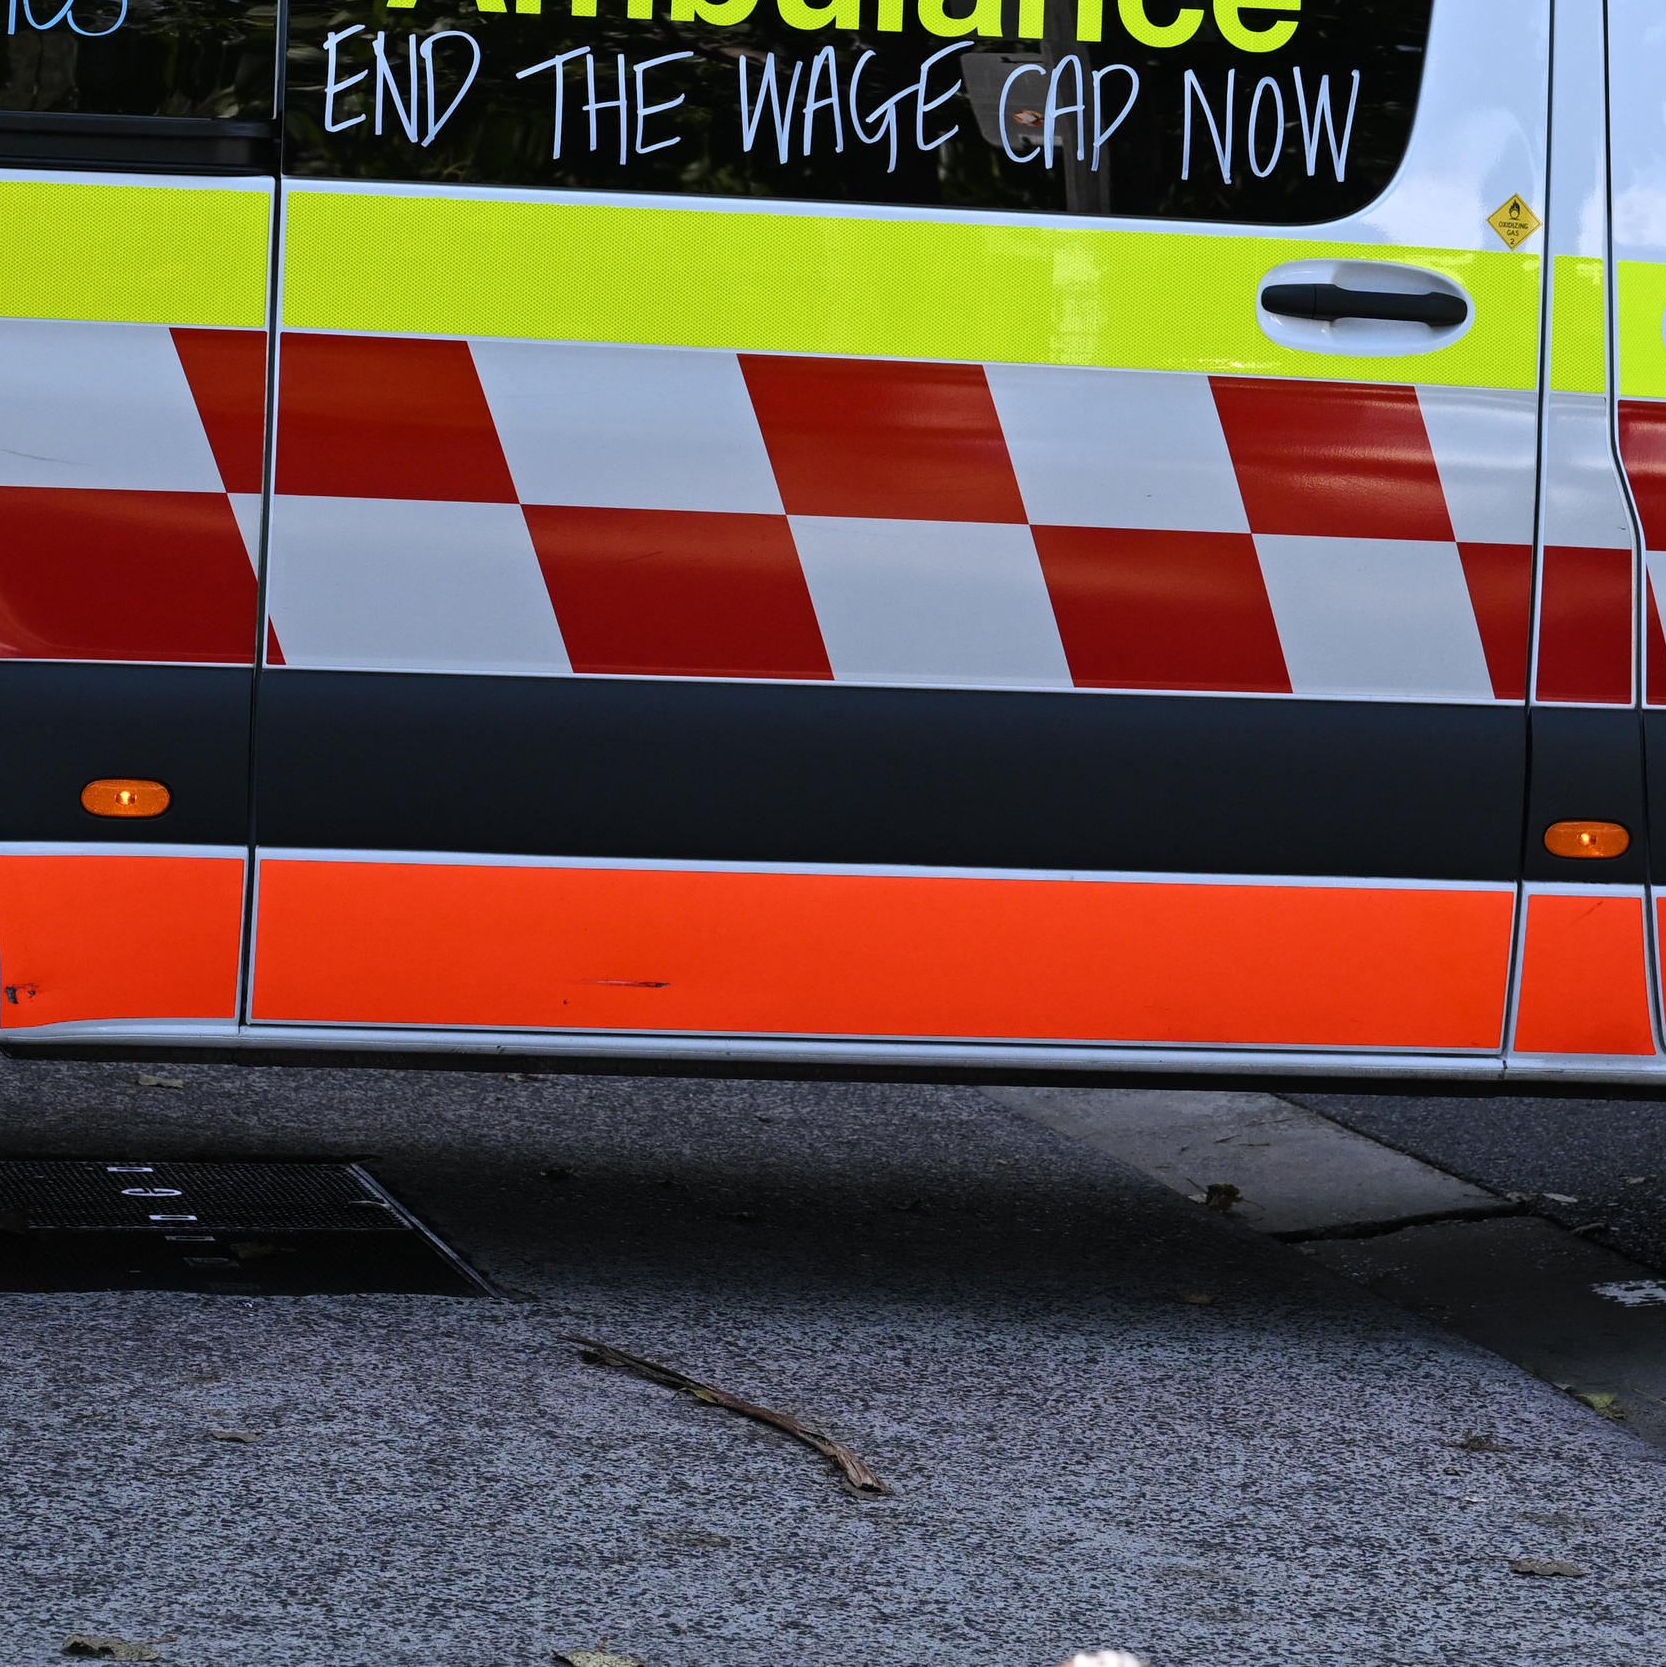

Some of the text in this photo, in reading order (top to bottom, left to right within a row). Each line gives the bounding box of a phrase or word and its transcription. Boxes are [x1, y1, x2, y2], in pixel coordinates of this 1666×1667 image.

[323, 24, 481, 148] END
[515, 46, 695, 166] THE
[738, 40, 974, 173] WAGE
[1180, 66, 1361, 185] NOW
[1506, 229, 1519, 237] GAS
[1509, 237, 1515, 245] 2
